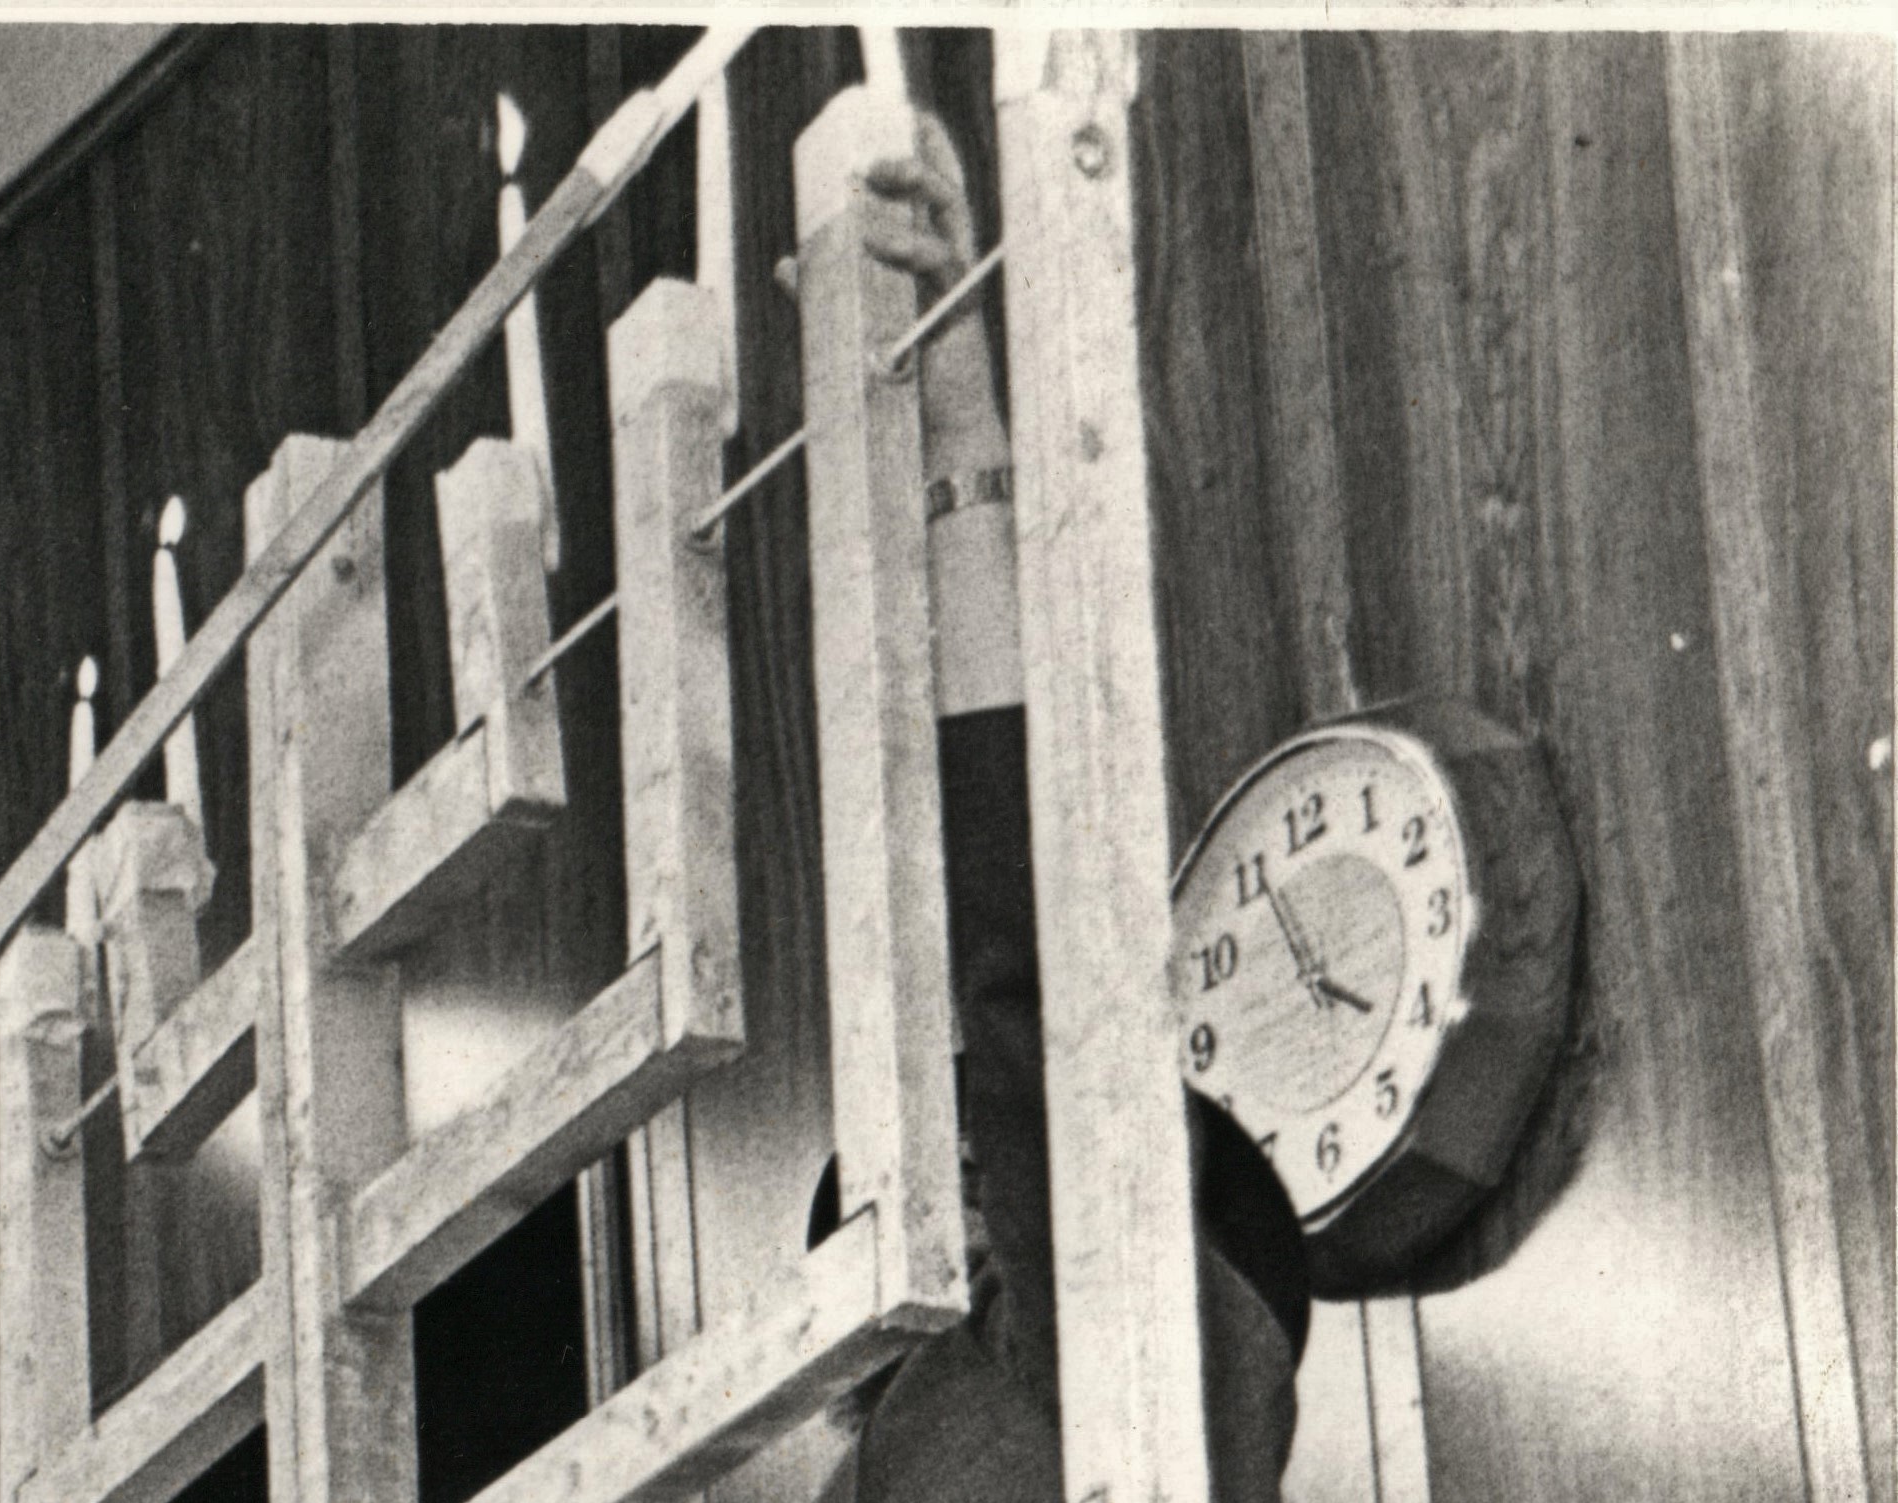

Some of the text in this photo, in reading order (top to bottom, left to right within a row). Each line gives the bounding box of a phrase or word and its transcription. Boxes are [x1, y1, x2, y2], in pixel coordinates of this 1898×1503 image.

[1283, 793, 1328, 856] 12
[1361, 785, 1381, 834] 1
[1403, 815, 1427, 867] 2
[1234, 852, 1267, 906] 11
[1428, 888, 1451, 937] 3
[1195, 932, 1239, 991] 10
[1409, 981, 1433, 1029] 4
[1190, 1023, 1216, 1072] 9
[1375, 1069, 1398, 1120] 5
[1315, 1122, 1341, 1173] 6
